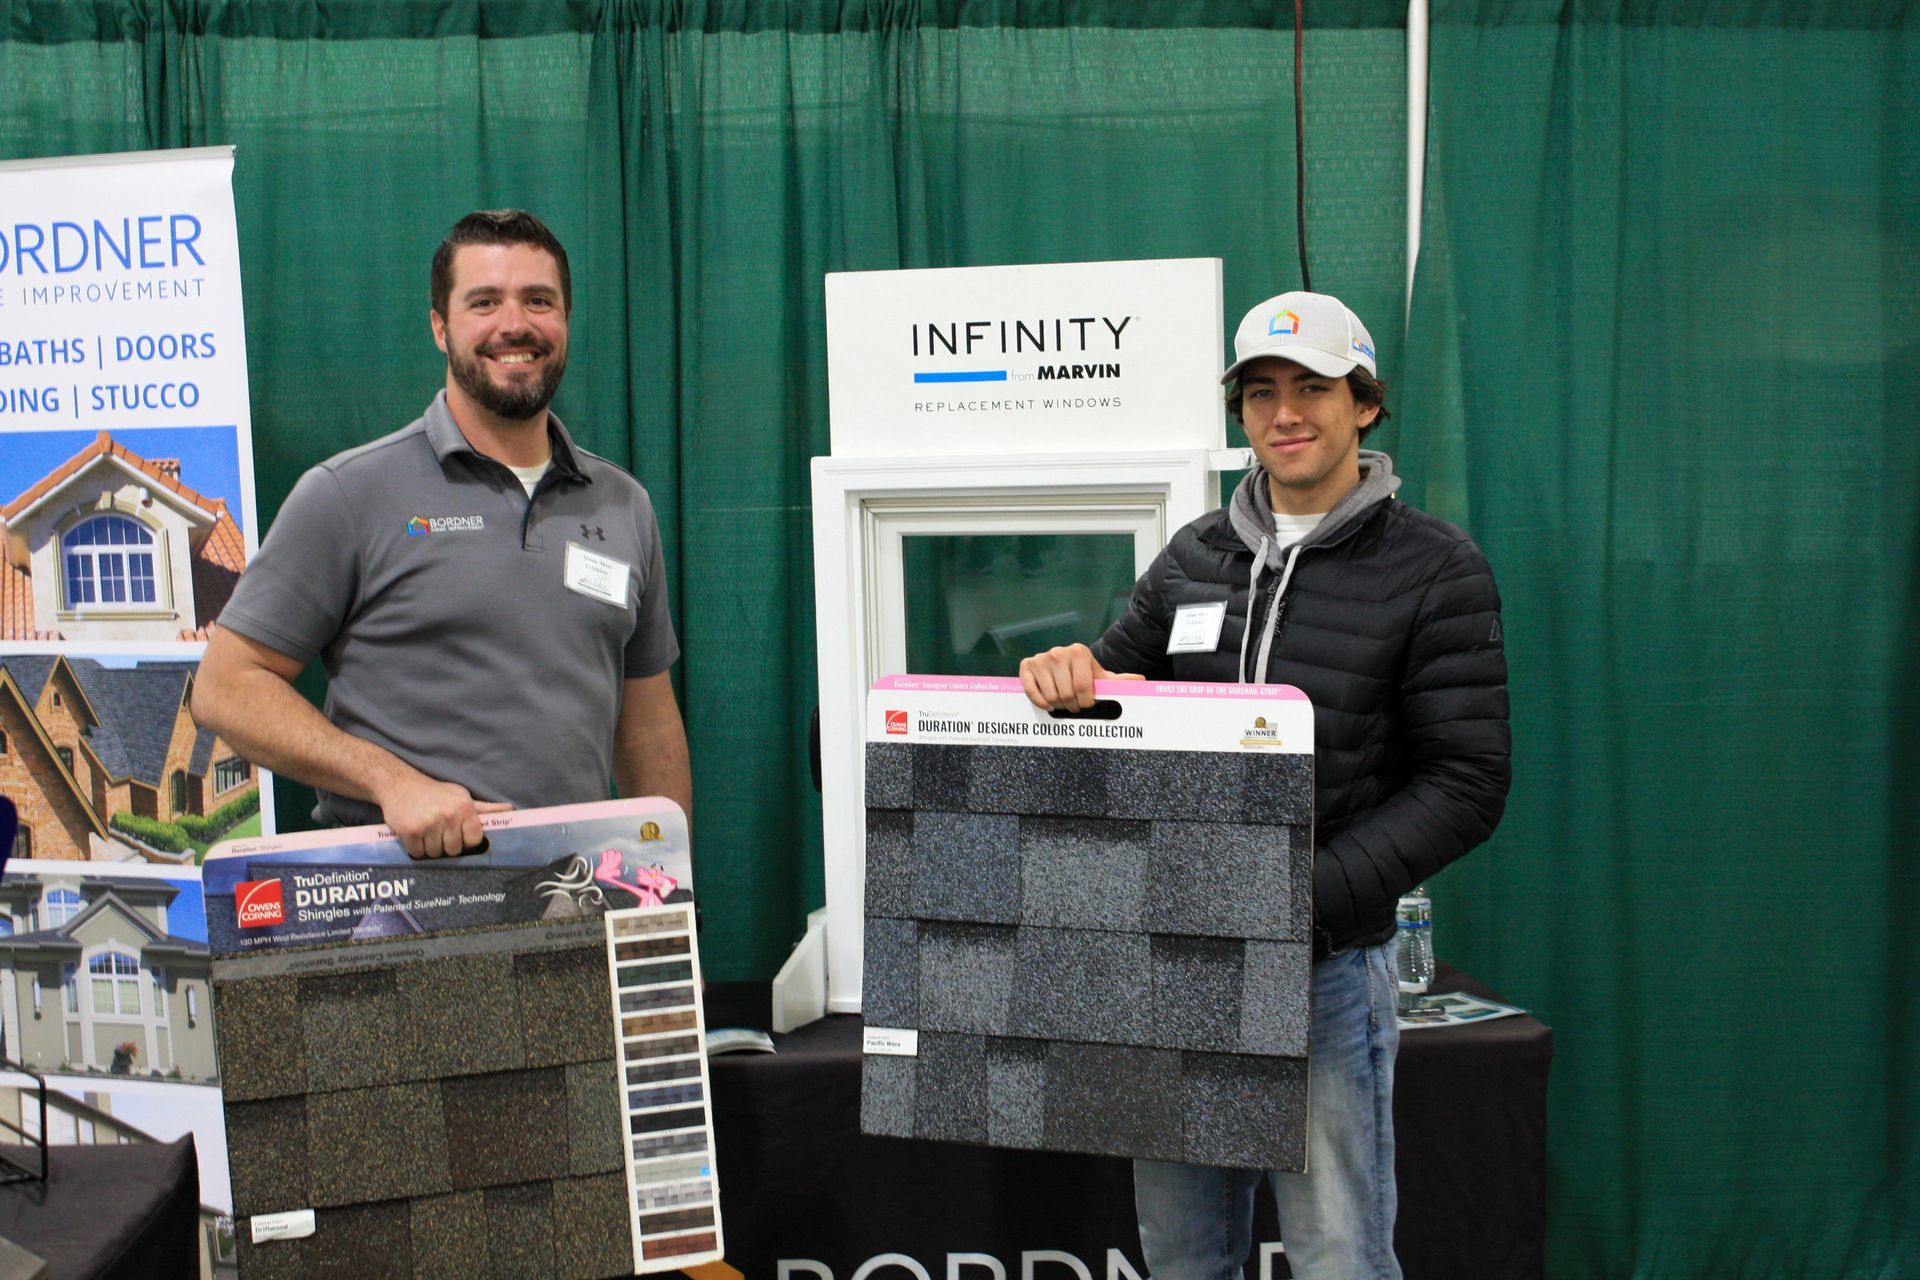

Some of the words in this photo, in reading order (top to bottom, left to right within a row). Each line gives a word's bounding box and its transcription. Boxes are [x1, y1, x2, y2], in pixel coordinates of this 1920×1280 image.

[0, 214, 206, 275] RDNER
[23, 278, 205, 305] IMPROVEMENT
[0, 338, 86, 366] BATHS
[115, 332, 217, 362] DOORS
[1011, 370, 1035, 381] from
[1037, 363, 1121, 381] MARVIN
[91, 382, 200, 410] STUCCO
[914, 399, 1035, 412] REPLACEMENT
[1042, 396, 1122, 408] WINDOWS
[429, 515, 484, 527] BORDNER
[922, 681, 948, 690] Designer
[969, 682, 1000, 690] Collection
[1155, 685, 1175, 693] TRUST
[1176, 685, 1188, 693] THE
[1189, 686, 1204, 694] GRIP
[1205, 686, 1214, 694] OF
[1215, 686, 1227, 694] THE
[977, 721, 1029, 735] DESIGNER
[1032, 723, 1075, 736] COLORS
[1078, 724, 1143, 739] COLLECTION
[1245, 729, 1276, 737] WINNER
[247, 902, 281, 912] OWENS
[298, 906, 350, 922] Shingles
[352, 904, 371, 916] with
[373, 899, 412, 914] Patented
[458, 891, 506, 904] Technology
[241, 910, 282, 921] CORNING
[253, 936, 271, 944] MPH
[272, 933, 290, 942] Wind
[290, 930, 326, 941] Resistance
[326, 927, 351, 937] Limited
[545, 928, 582, 940] Owens
[255, 1223, 289, 1233] Driftwood
